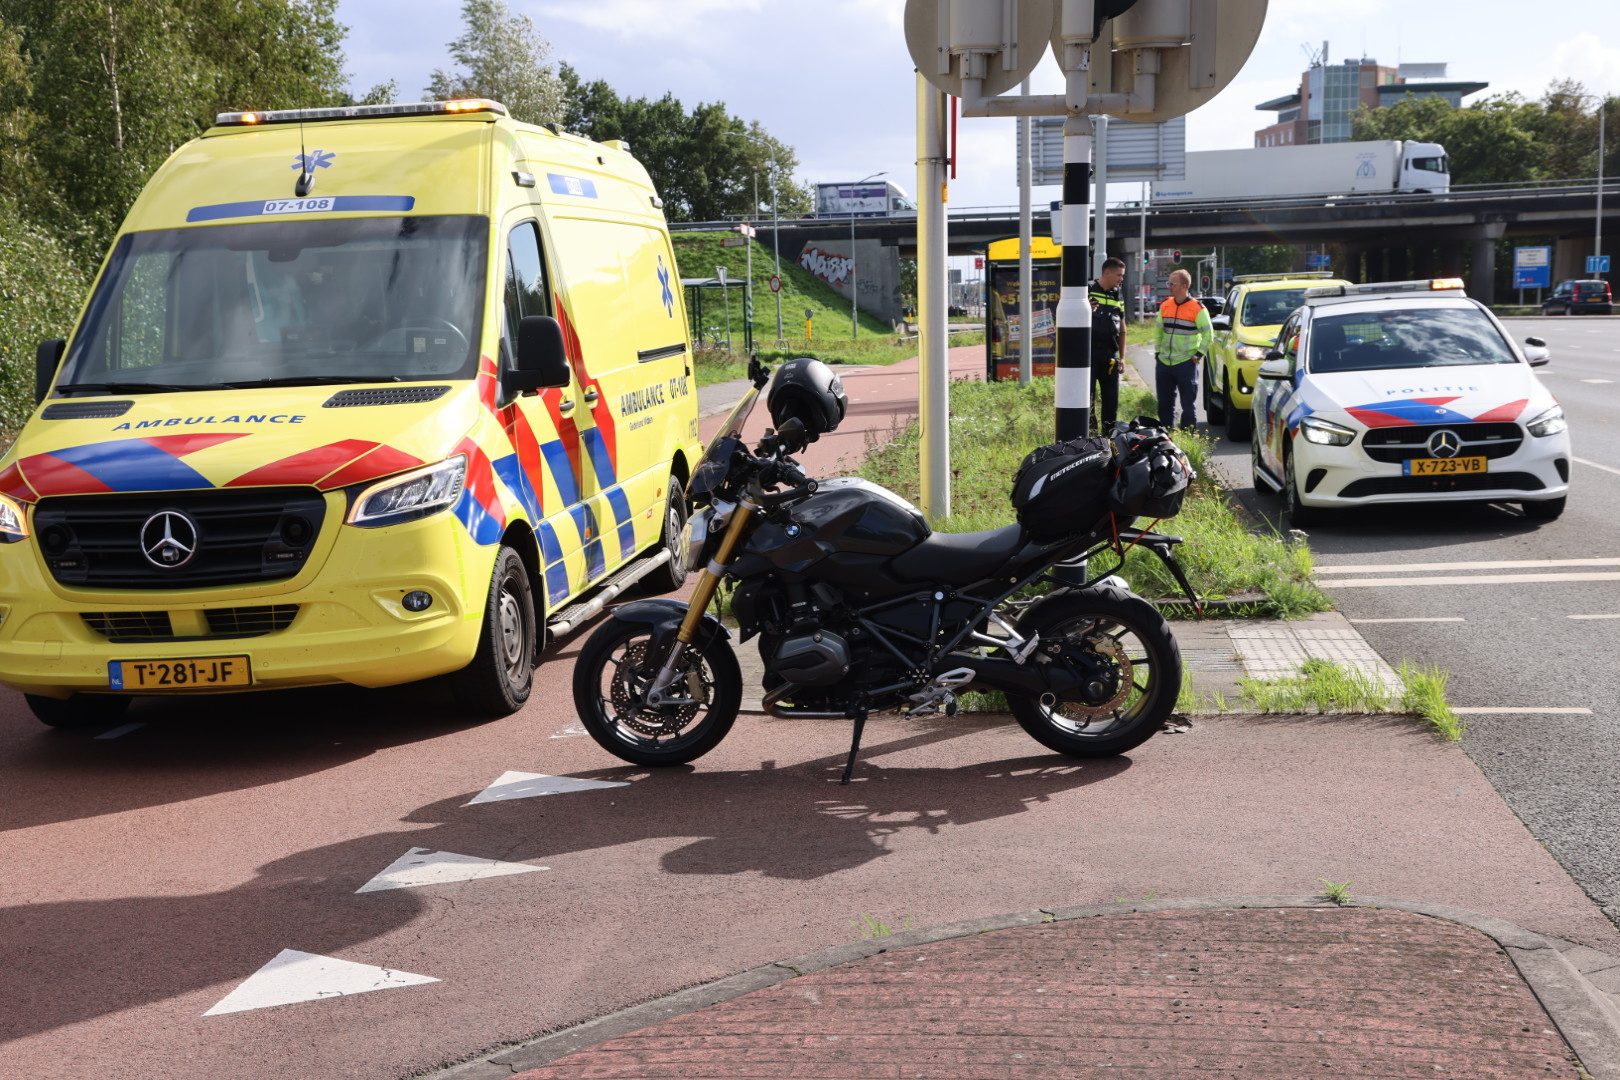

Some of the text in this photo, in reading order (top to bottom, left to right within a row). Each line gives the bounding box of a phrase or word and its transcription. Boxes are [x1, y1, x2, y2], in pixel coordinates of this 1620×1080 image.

[265, 199, 330, 212] 07-108
[1386, 386, 1479, 396] POLITIE
[620, 384, 665, 418] AMBULANCE
[111, 414, 307, 431] AMBULANCE
[1417, 459, 1480, 473] X-723-VB
